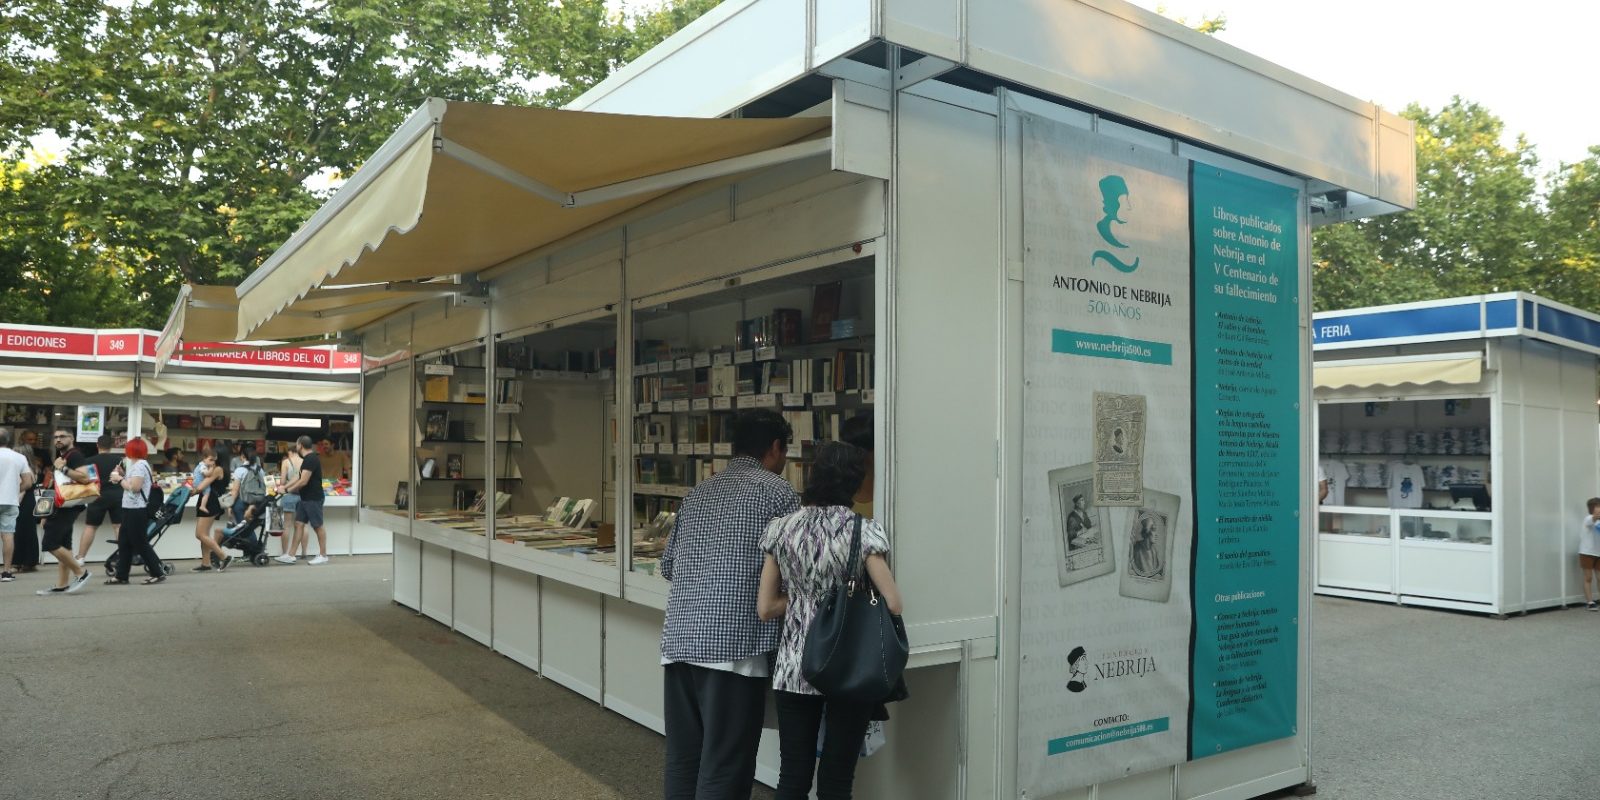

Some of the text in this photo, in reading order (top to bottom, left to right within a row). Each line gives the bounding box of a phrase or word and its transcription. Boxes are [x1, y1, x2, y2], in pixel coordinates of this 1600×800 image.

[1213, 206, 1282, 234] Libros publicados
[1213, 226, 1281, 251] sobre Antonio de
[1213, 243, 1266, 266] Nebrija en el
[1214, 262, 1279, 286] V Centenario de
[1052, 274, 1172, 307] ANTONIO DE NEBRIJA
[1213, 282, 1277, 303] su fallecimiento
[1087, 299, 1141, 320] 500 AÑOS
[7, 334, 67, 349] EDICIONES
[1321, 324, 1352, 338] FERIA
[109, 340, 125, 350] 349
[257, 350, 291, 362] LIBROS
[293, 352, 311, 363] DEL
[313, 354, 326, 364] KO
[343, 354, 358, 363] 348
[1214, 589, 1266, 604] Otras publicaciones
[1093, 656, 1156, 681] NEBRIJA
[1093, 713, 1130, 727] CONTACTO:
